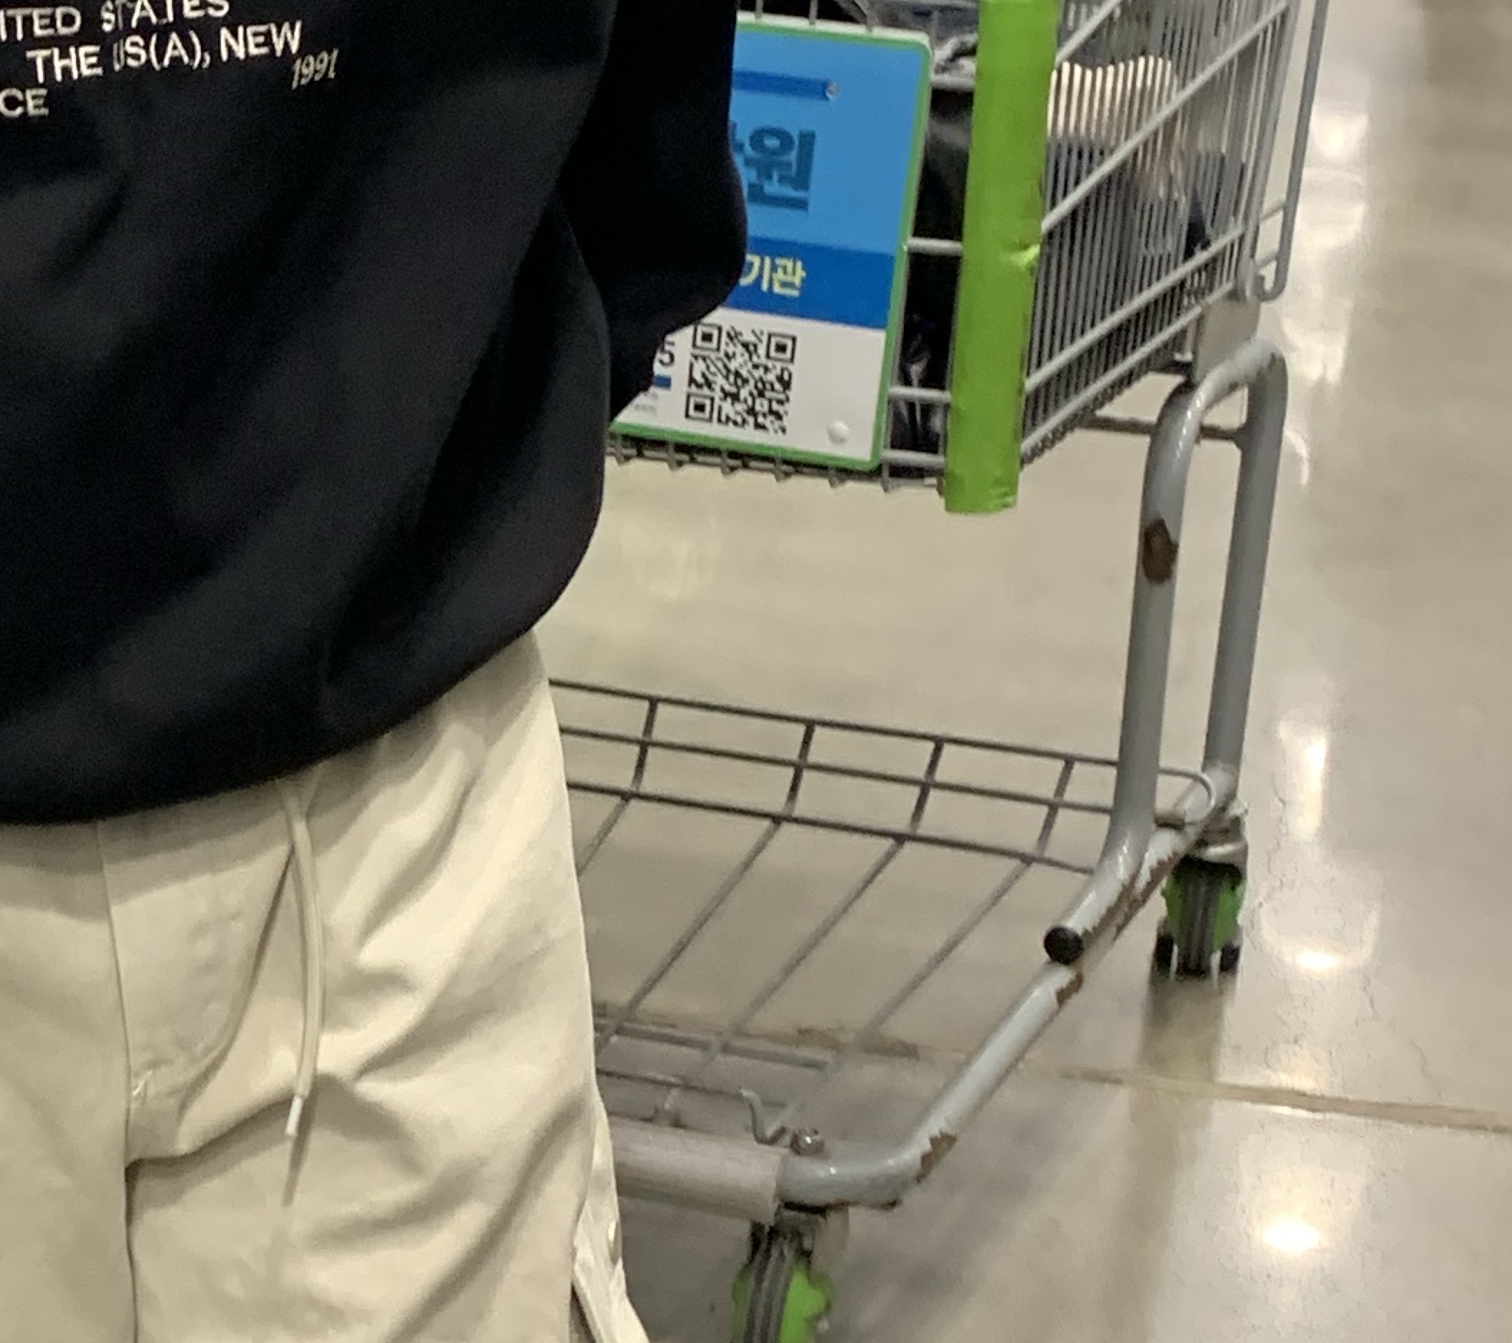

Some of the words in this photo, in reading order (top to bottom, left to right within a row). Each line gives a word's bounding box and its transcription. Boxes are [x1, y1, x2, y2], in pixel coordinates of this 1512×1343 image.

[26, 45, 103, 84] THE
[219, 19, 302, 62] NEW
[728, 122, 816, 212] 원
